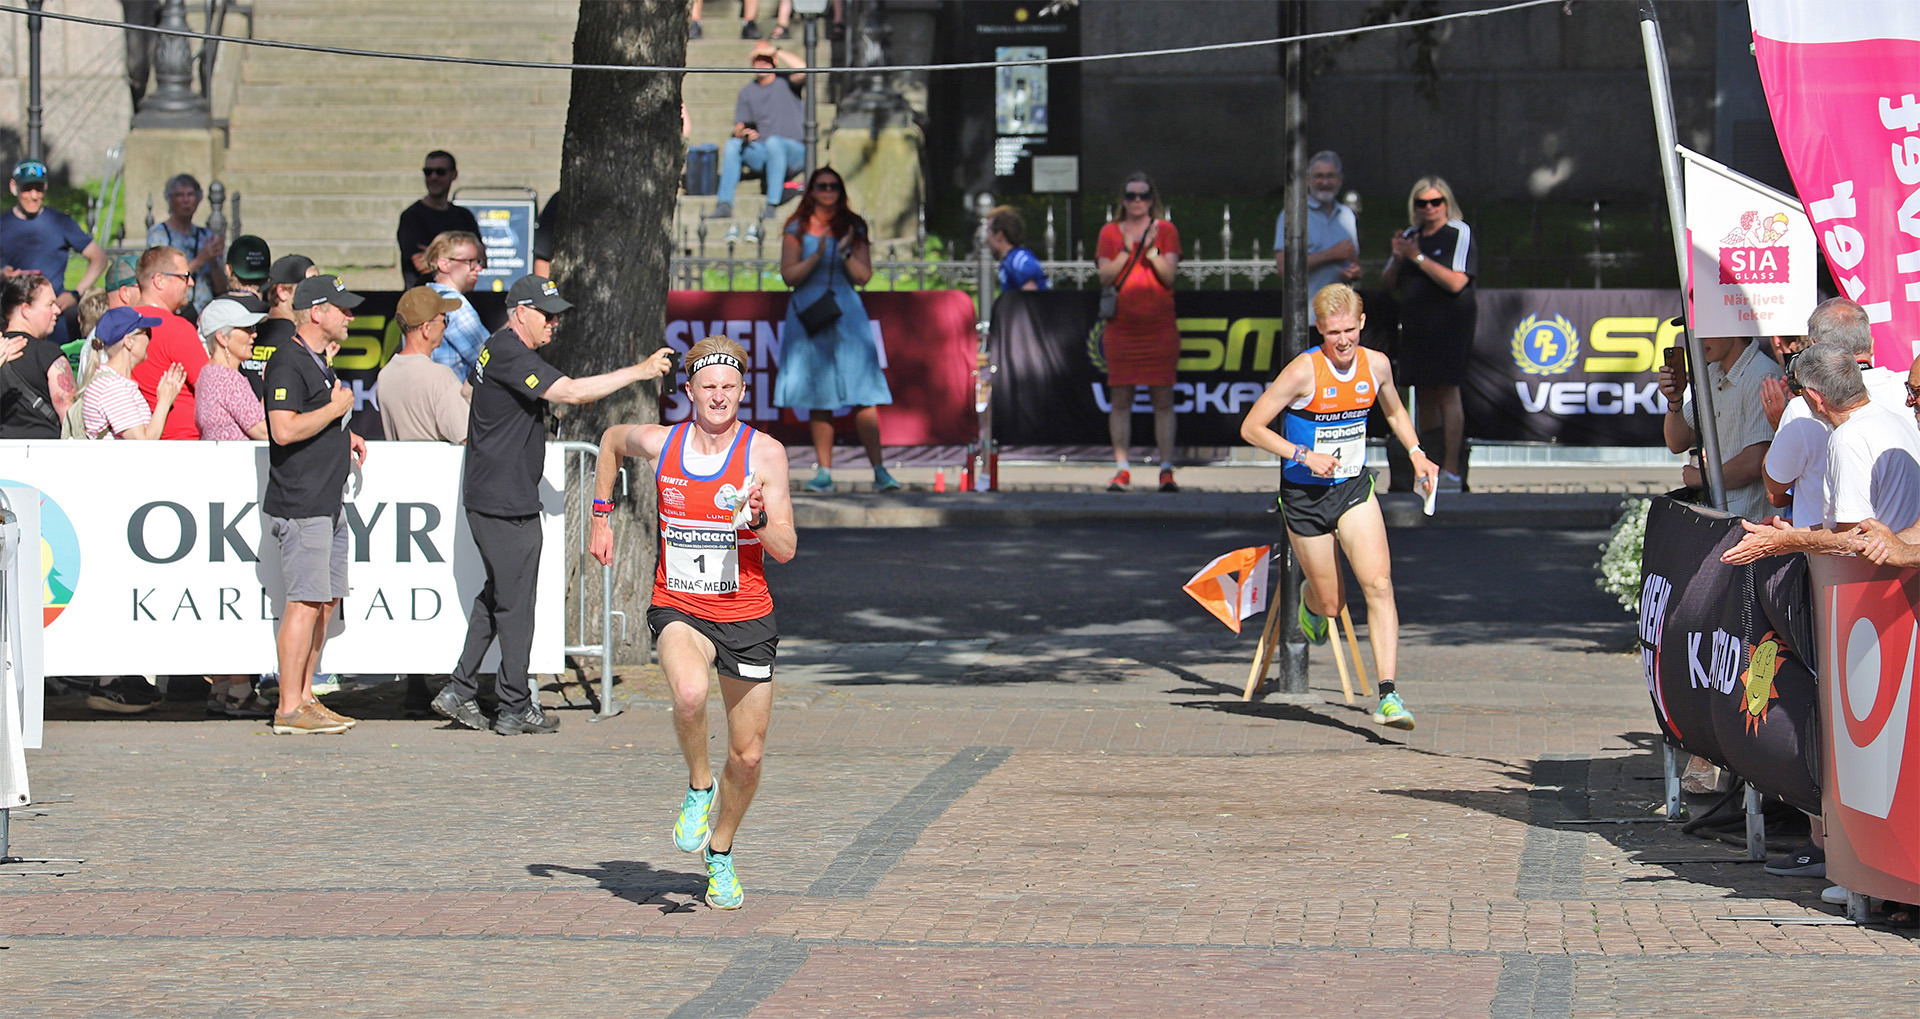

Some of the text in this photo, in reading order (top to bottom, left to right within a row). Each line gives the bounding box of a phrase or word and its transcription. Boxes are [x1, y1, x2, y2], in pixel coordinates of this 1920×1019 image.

[1731, 250, 1777, 271] SIA
[1735, 272, 1774, 280] GLASS
[1724, 293, 1784, 305] När livet
[1738, 309, 1773, 321] leker
[693, 353, 739, 372] TRIMTEX
[1091, 382, 1271, 413] VECKA
[1315, 413, 1340, 421] KFUM
[1317, 425, 1364, 439] bagheera
[1332, 447, 1341, 460] 4
[660, 475, 688, 487] TRIMTEX
[127, 501, 446, 564] OK YR
[667, 527, 735, 543] bagheera
[694, 554, 706, 573] 1
[668, 577, 738, 592] ERNA MEDIA
[133, 587, 442, 621] KARLAD
